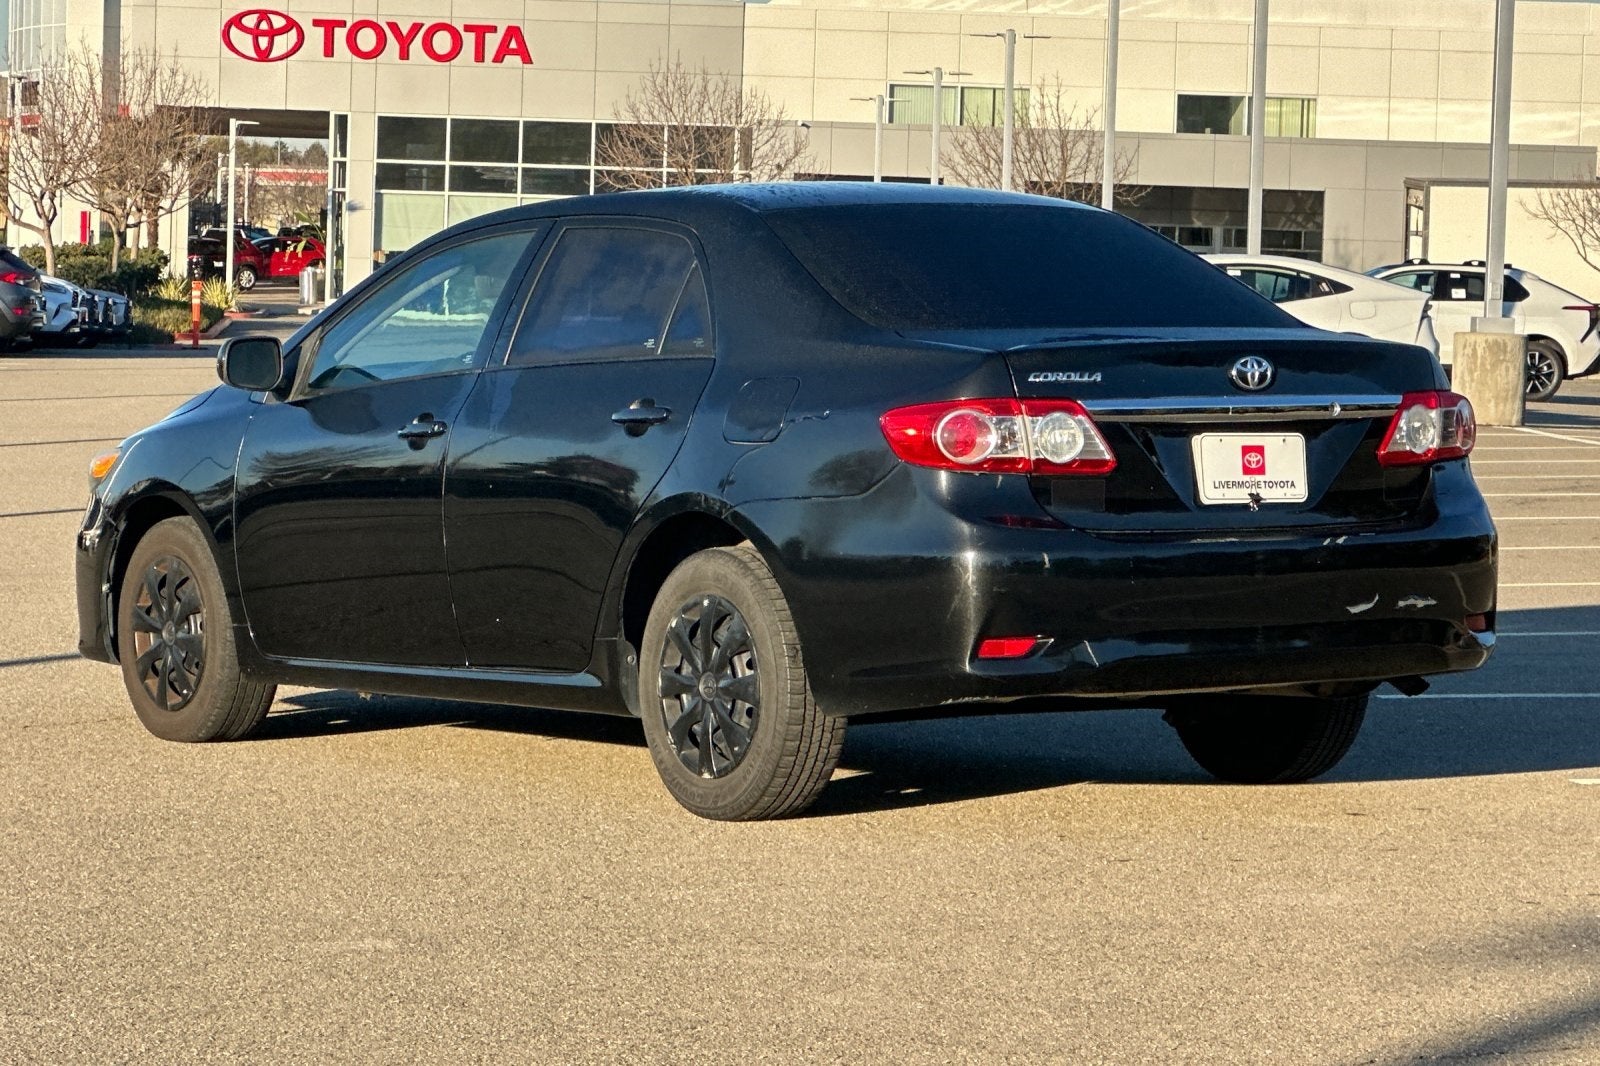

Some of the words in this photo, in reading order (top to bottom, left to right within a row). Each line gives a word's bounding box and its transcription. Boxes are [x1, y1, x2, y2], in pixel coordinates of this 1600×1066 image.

[312, 19, 533, 64] TOYOTA
[1028, 372, 1102, 382] COROLLA
[1213, 480, 1261, 489] LIVERMORE
[1264, 480, 1296, 489] TOYOTA
